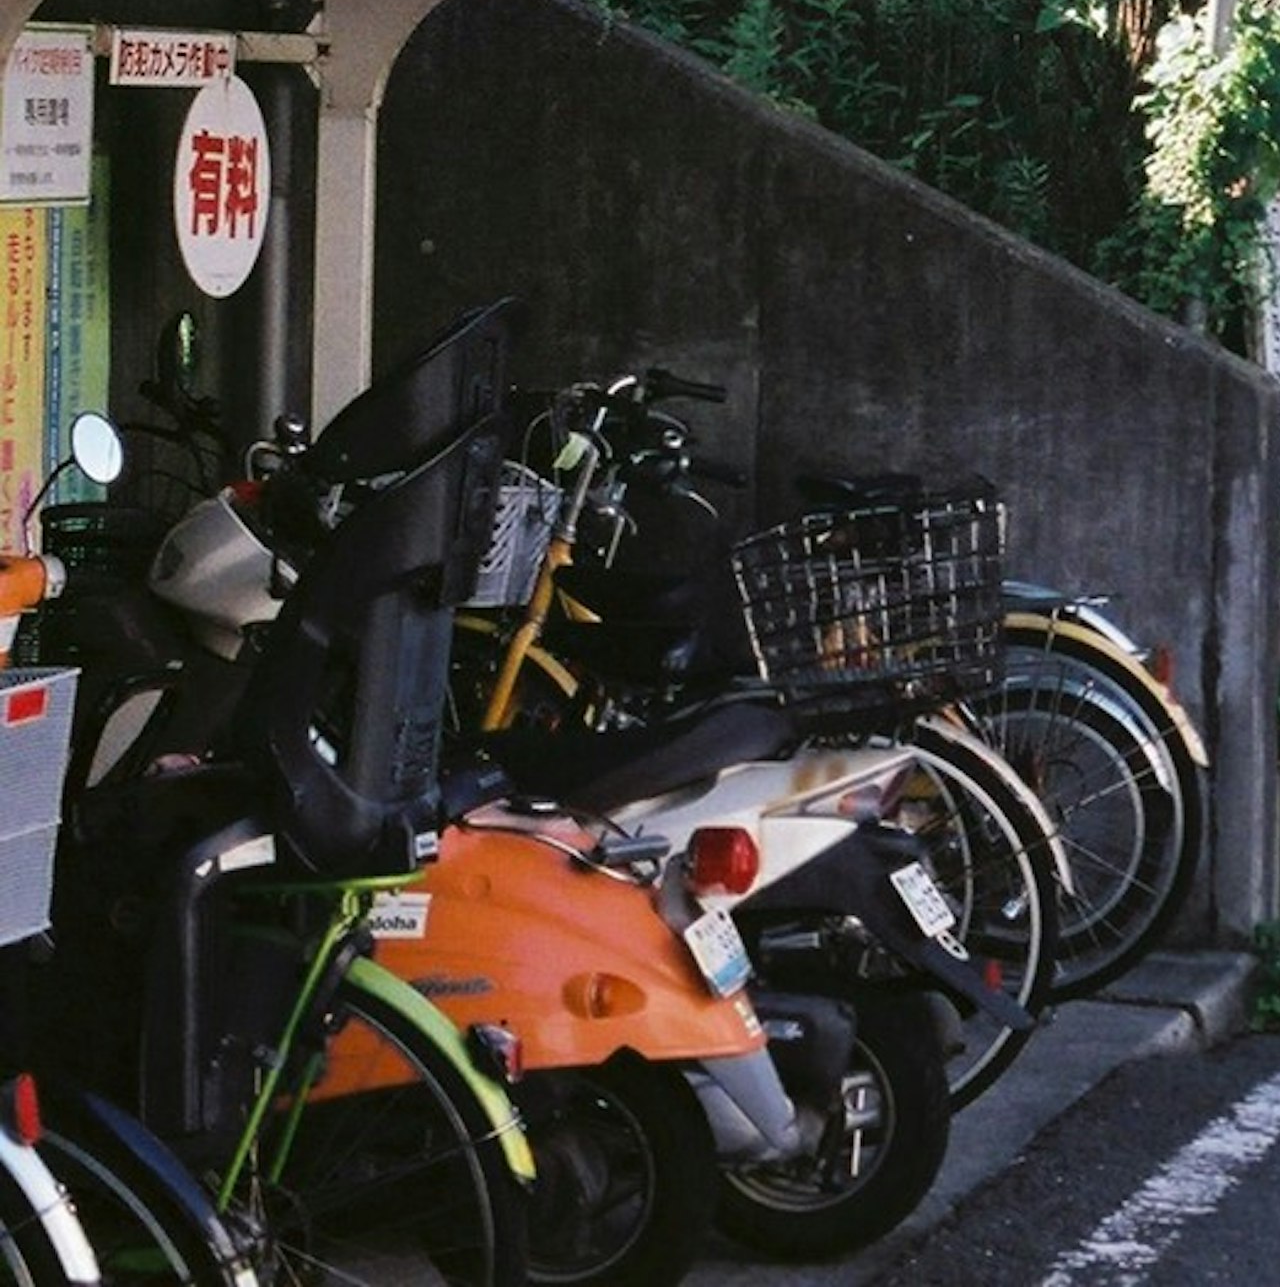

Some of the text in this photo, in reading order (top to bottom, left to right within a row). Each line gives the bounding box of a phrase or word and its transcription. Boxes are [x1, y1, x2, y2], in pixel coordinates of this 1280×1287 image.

[119, 39, 230, 78] 防犯カメラ作動中
[189, 129, 258, 239] 有料
